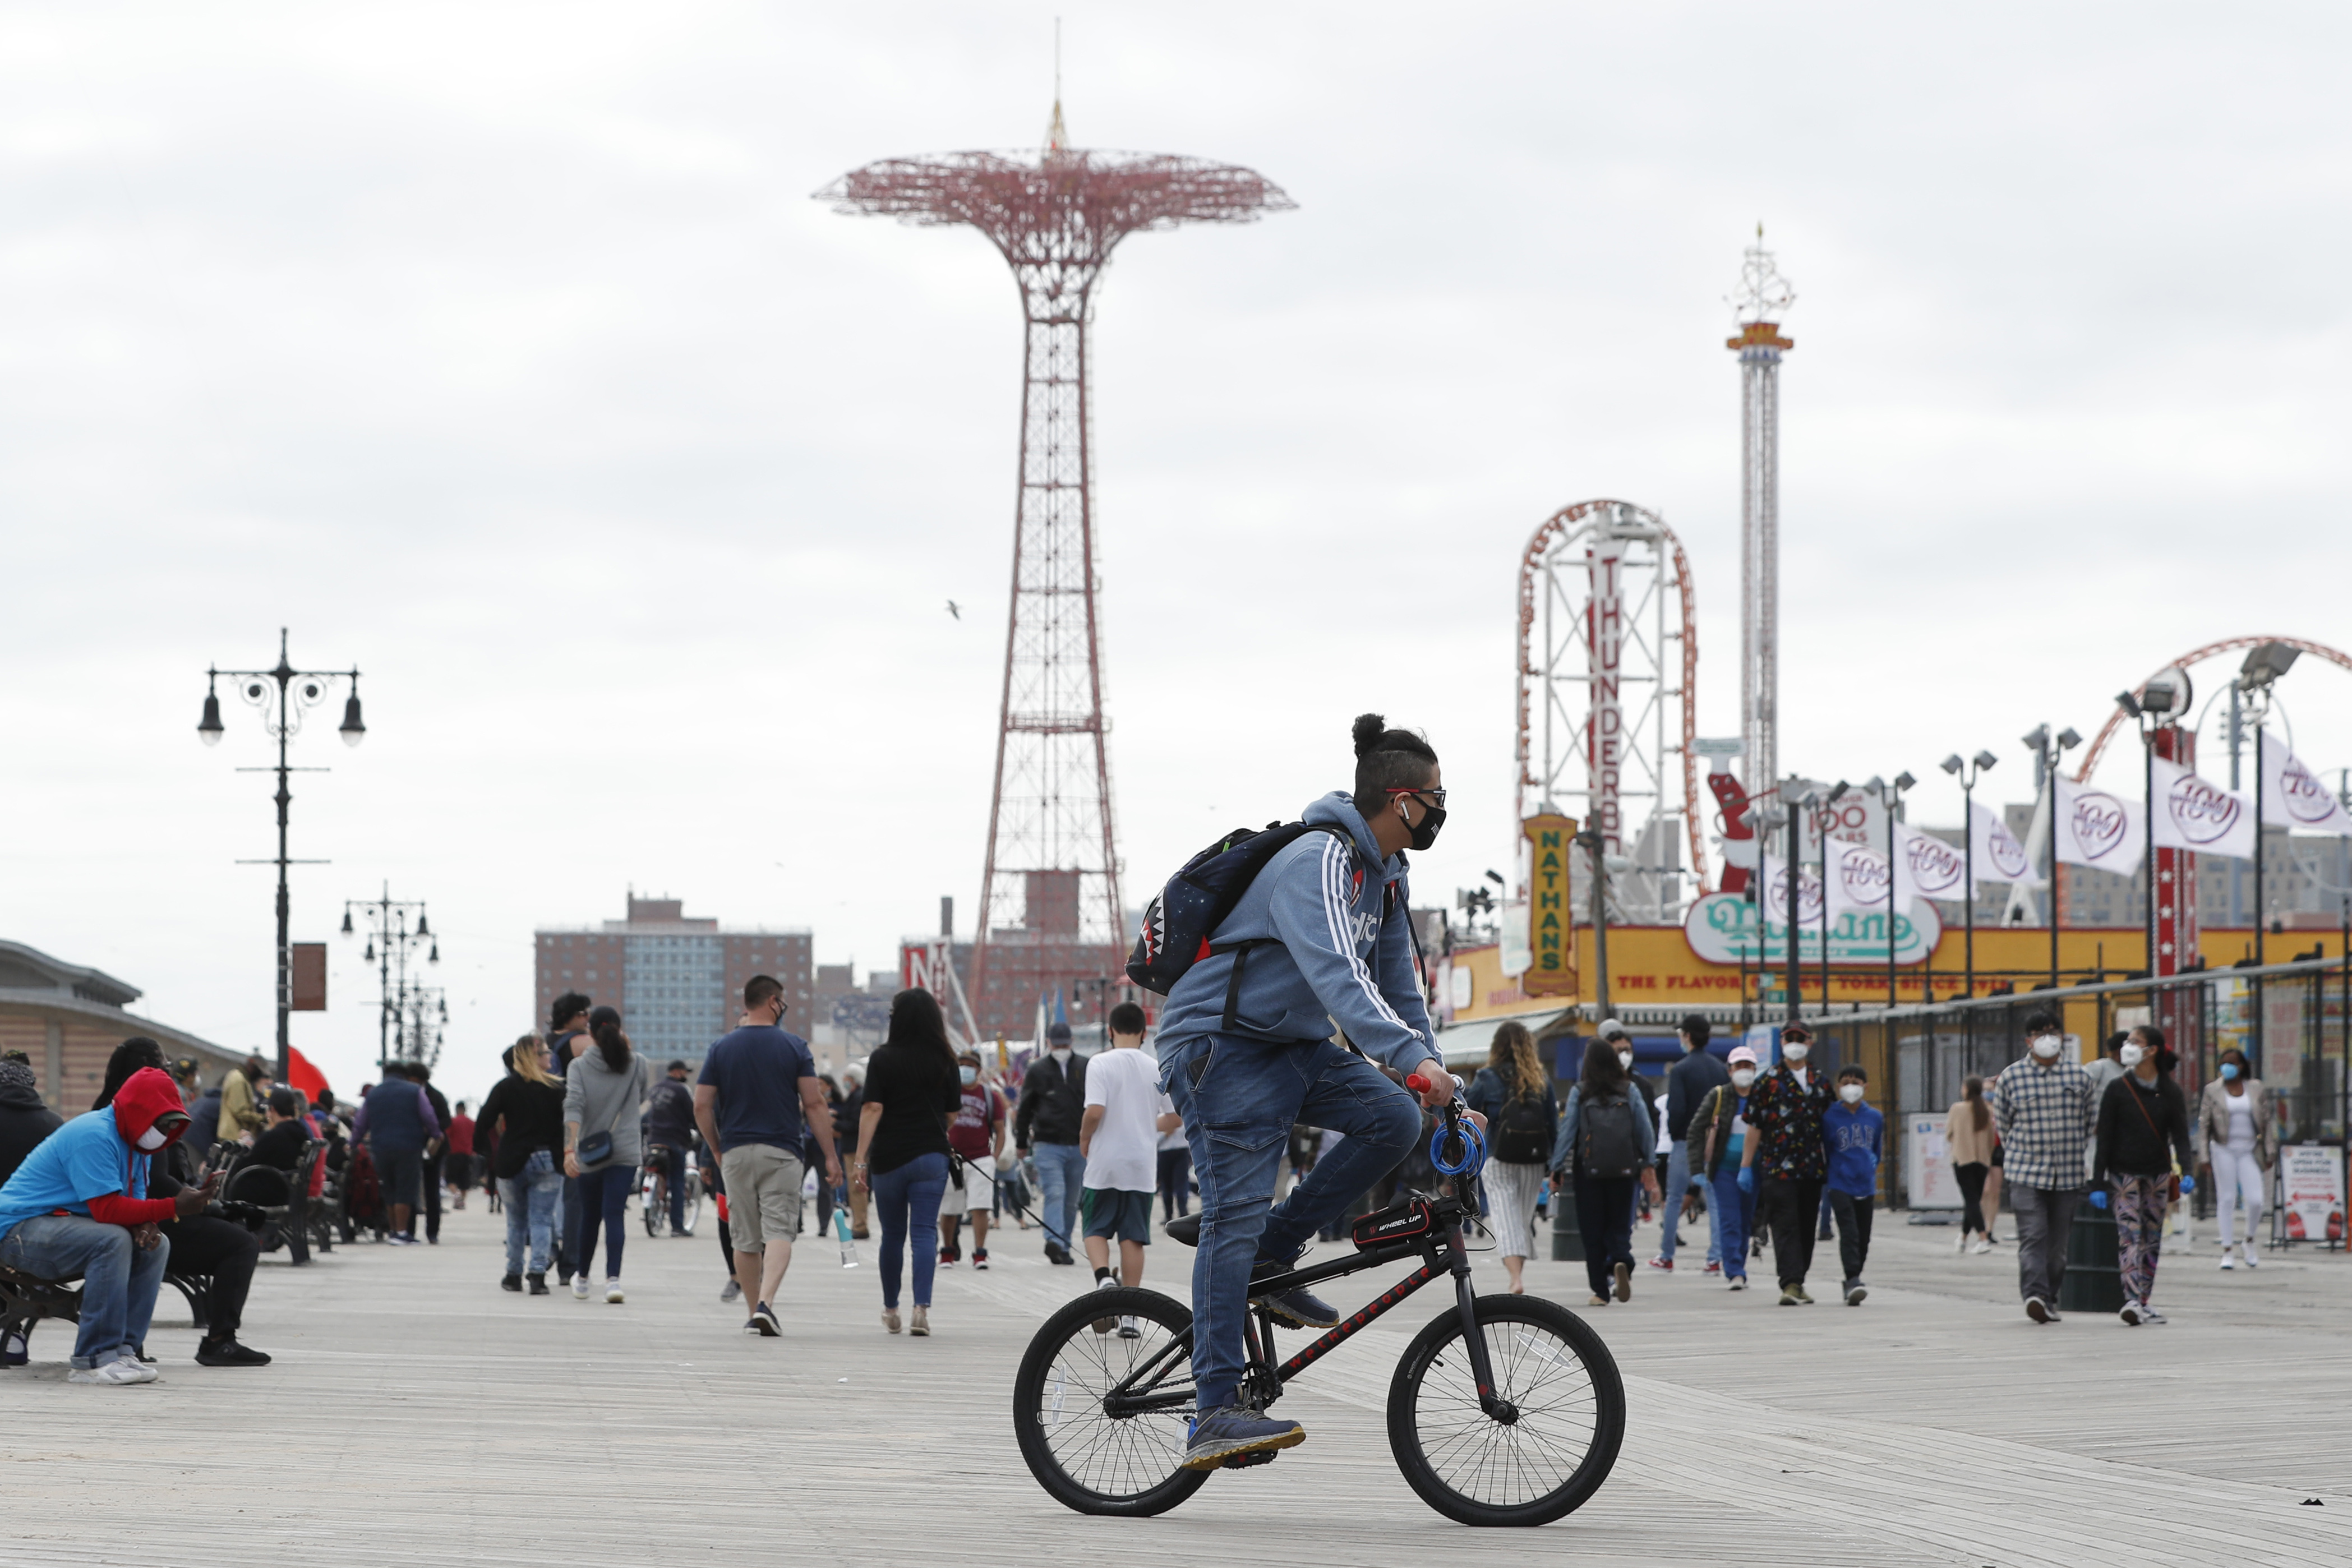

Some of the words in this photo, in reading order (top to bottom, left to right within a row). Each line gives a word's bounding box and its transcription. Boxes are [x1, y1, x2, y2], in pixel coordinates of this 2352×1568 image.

[1809, 805, 1868, 833] 100
[1809, 830, 1868, 849] YARS
[1541, 830, 1561, 970] NATHANS
[1617, 976, 1656, 989] THE
[1667, 976, 1741, 989] FLAVOR
[1378, 1219, 1407, 1232] WHEEL
